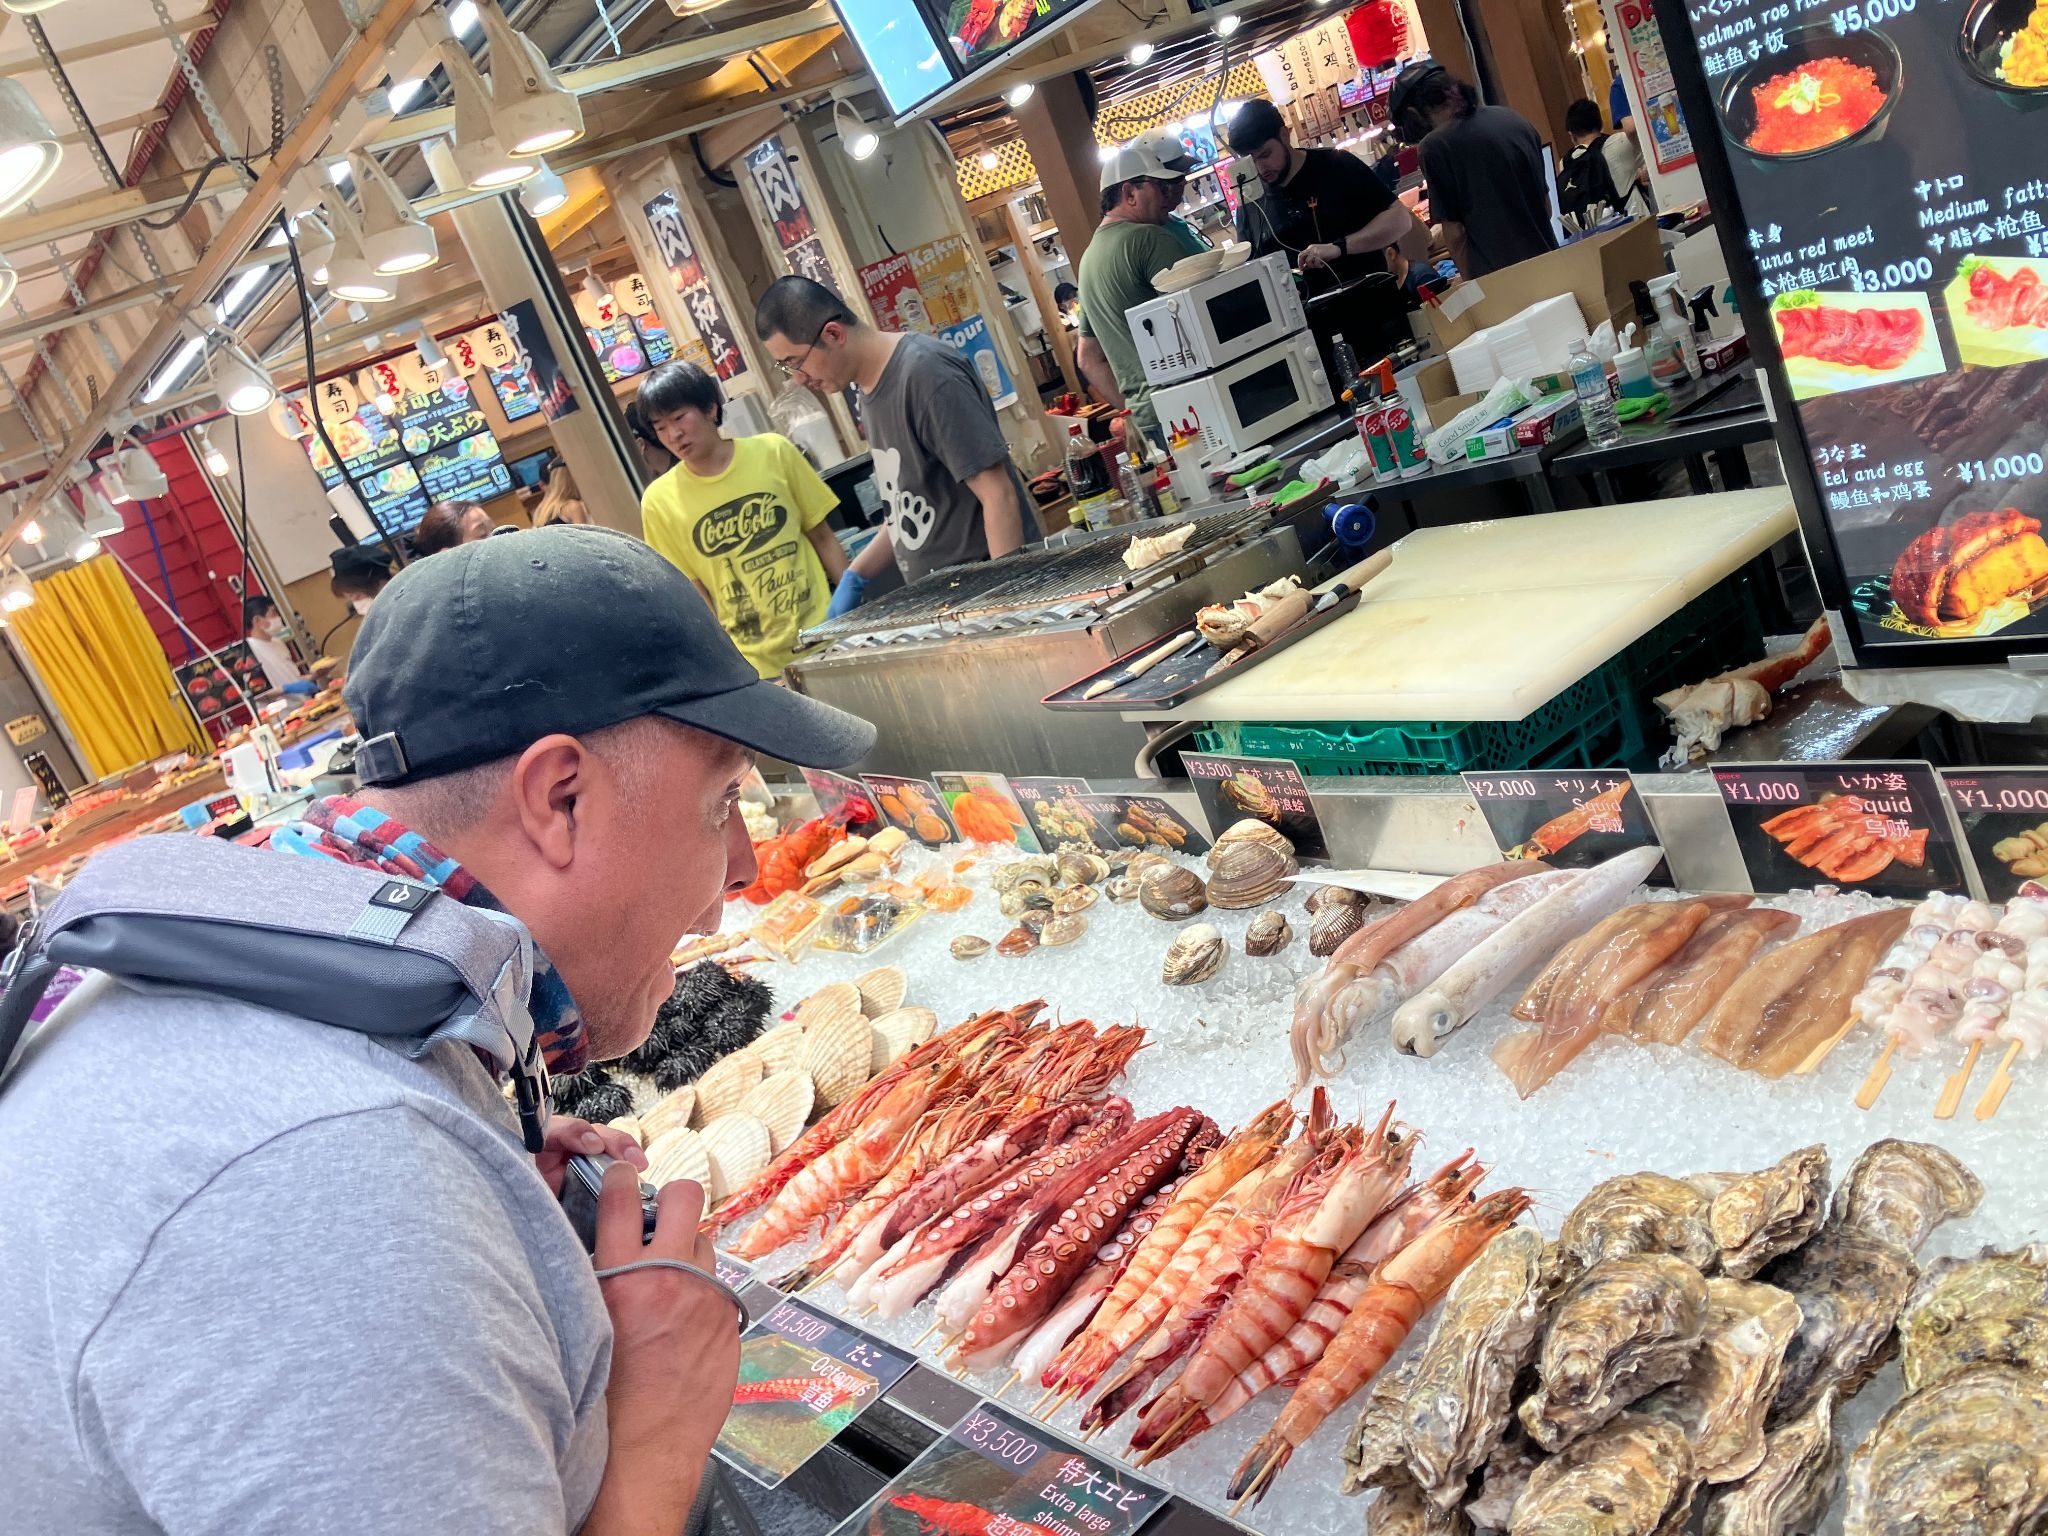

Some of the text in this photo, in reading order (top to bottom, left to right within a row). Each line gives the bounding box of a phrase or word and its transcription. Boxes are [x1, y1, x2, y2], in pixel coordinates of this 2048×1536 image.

[1699, 16, 1756, 49] salmon
[1761, 3, 1790, 25] roe
[1704, 28, 1789, 76] 鲑鱼子饭
[1914, 174, 1964, 201] 中トロ
[1919, 198, 1988, 228] Medium
[1928, 209, 2046, 254] 中脂金枪鱼
[909, 238, 960, 268] Kaku
[1755, 225, 1875, 272] una red meet
[1762, 255, 1859, 297] 金枪鱼红肉
[1851, 256, 1933, 293] ¥3,000
[1818, 443, 1866, 465] うな玉
[1958, 452, 2043, 483] ¥1,000
[1824, 460, 1925, 487] Eel and egg
[1829, 480, 1932, 510] 鳗鱼和鸡蛋
[1186, 760, 1233, 778] ¥3,500
[1838, 773, 1907, 791] いか姿
[1283, 785, 1308, 797] clam
[1469, 780, 1536, 798] ¥2,000
[1555, 779, 1621, 793] ヤリイカ
[1725, 782, 1800, 803] ¥1,000
[1572, 798, 1622, 816] Squid
[1849, 796, 1912, 815] Squid
[770, 1305, 827, 1342] ¥1,500
[846, 1343, 882, 1368] たこ
[811, 1356, 871, 1398] Octopus
[800, 1383, 833, 1413] 章鱼
[963, 1413, 1038, 1465] ¥3,500
[1055, 1457, 1146, 1511] 特大エビ
[1040, 1484, 1111, 1531] Extra large
